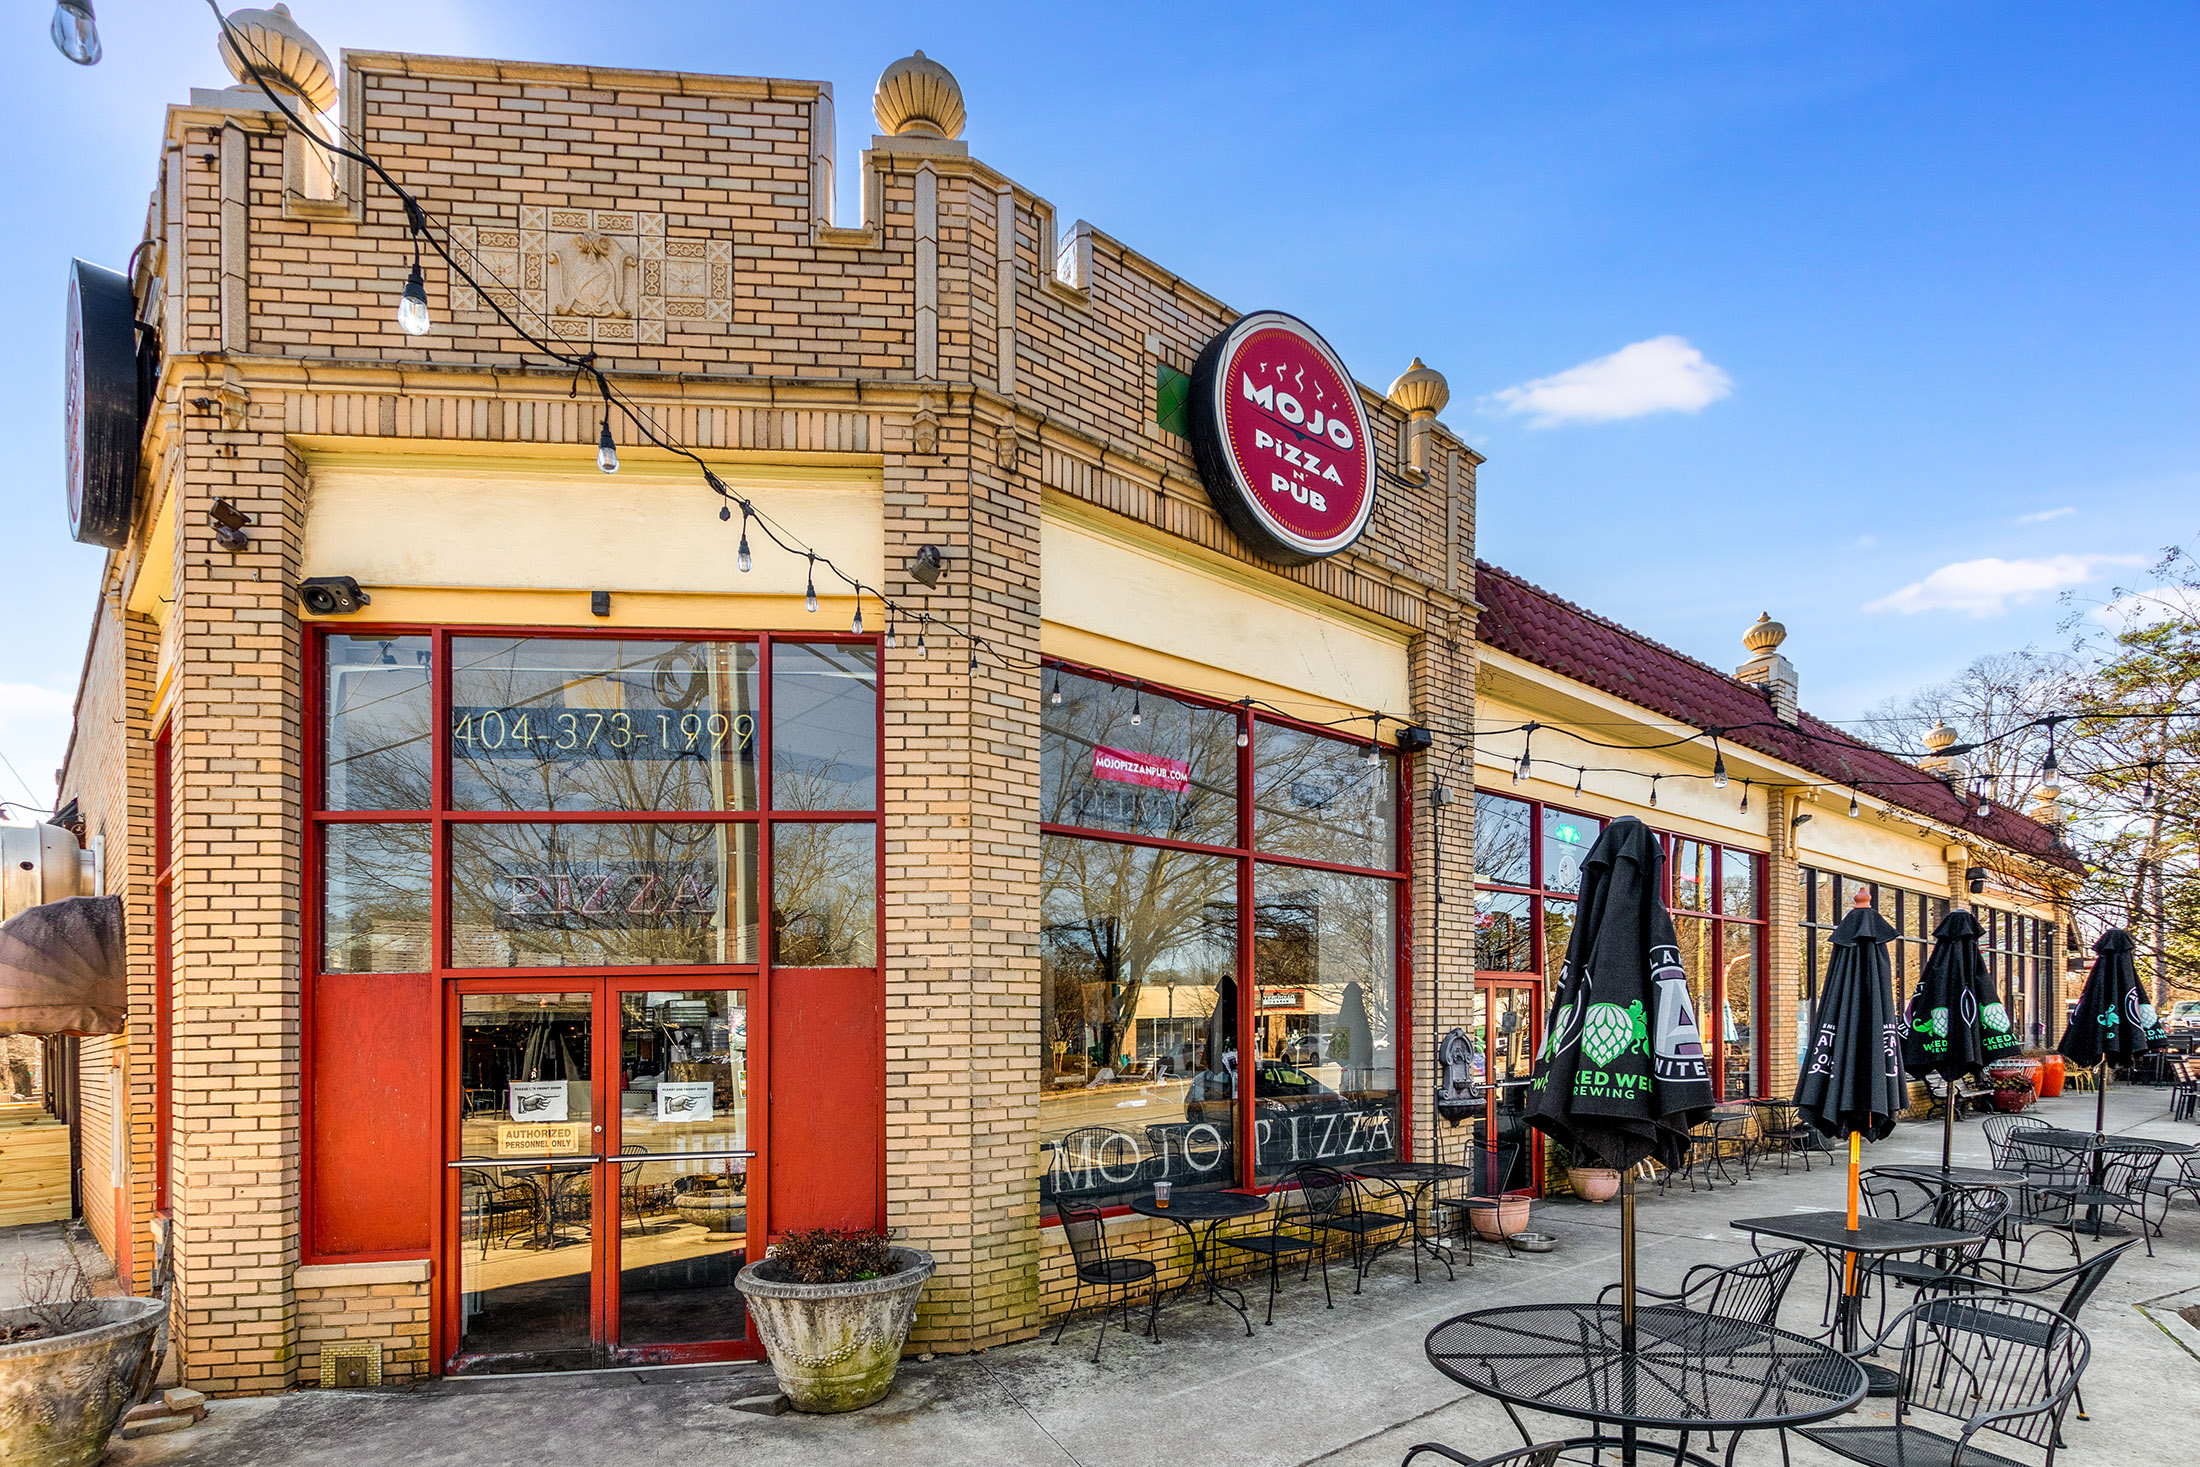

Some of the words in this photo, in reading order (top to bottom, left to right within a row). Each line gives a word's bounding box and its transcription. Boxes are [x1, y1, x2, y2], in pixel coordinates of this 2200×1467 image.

[1243, 371, 1354, 450] MOJO
[1271, 472, 1327, 512] PUB
[454, 710, 756, 751] 404-373-1999
[504, 873, 718, 916] PIZZA
[505, 1140, 550, 1149] PERSONNEL
[551, 1139, 572, 1148] ONLY
[506, 1128, 572, 1140] AUTHORIZED
[1050, 1122, 1223, 1194] MOJO
[1254, 1108, 1395, 1166] PIZZA
